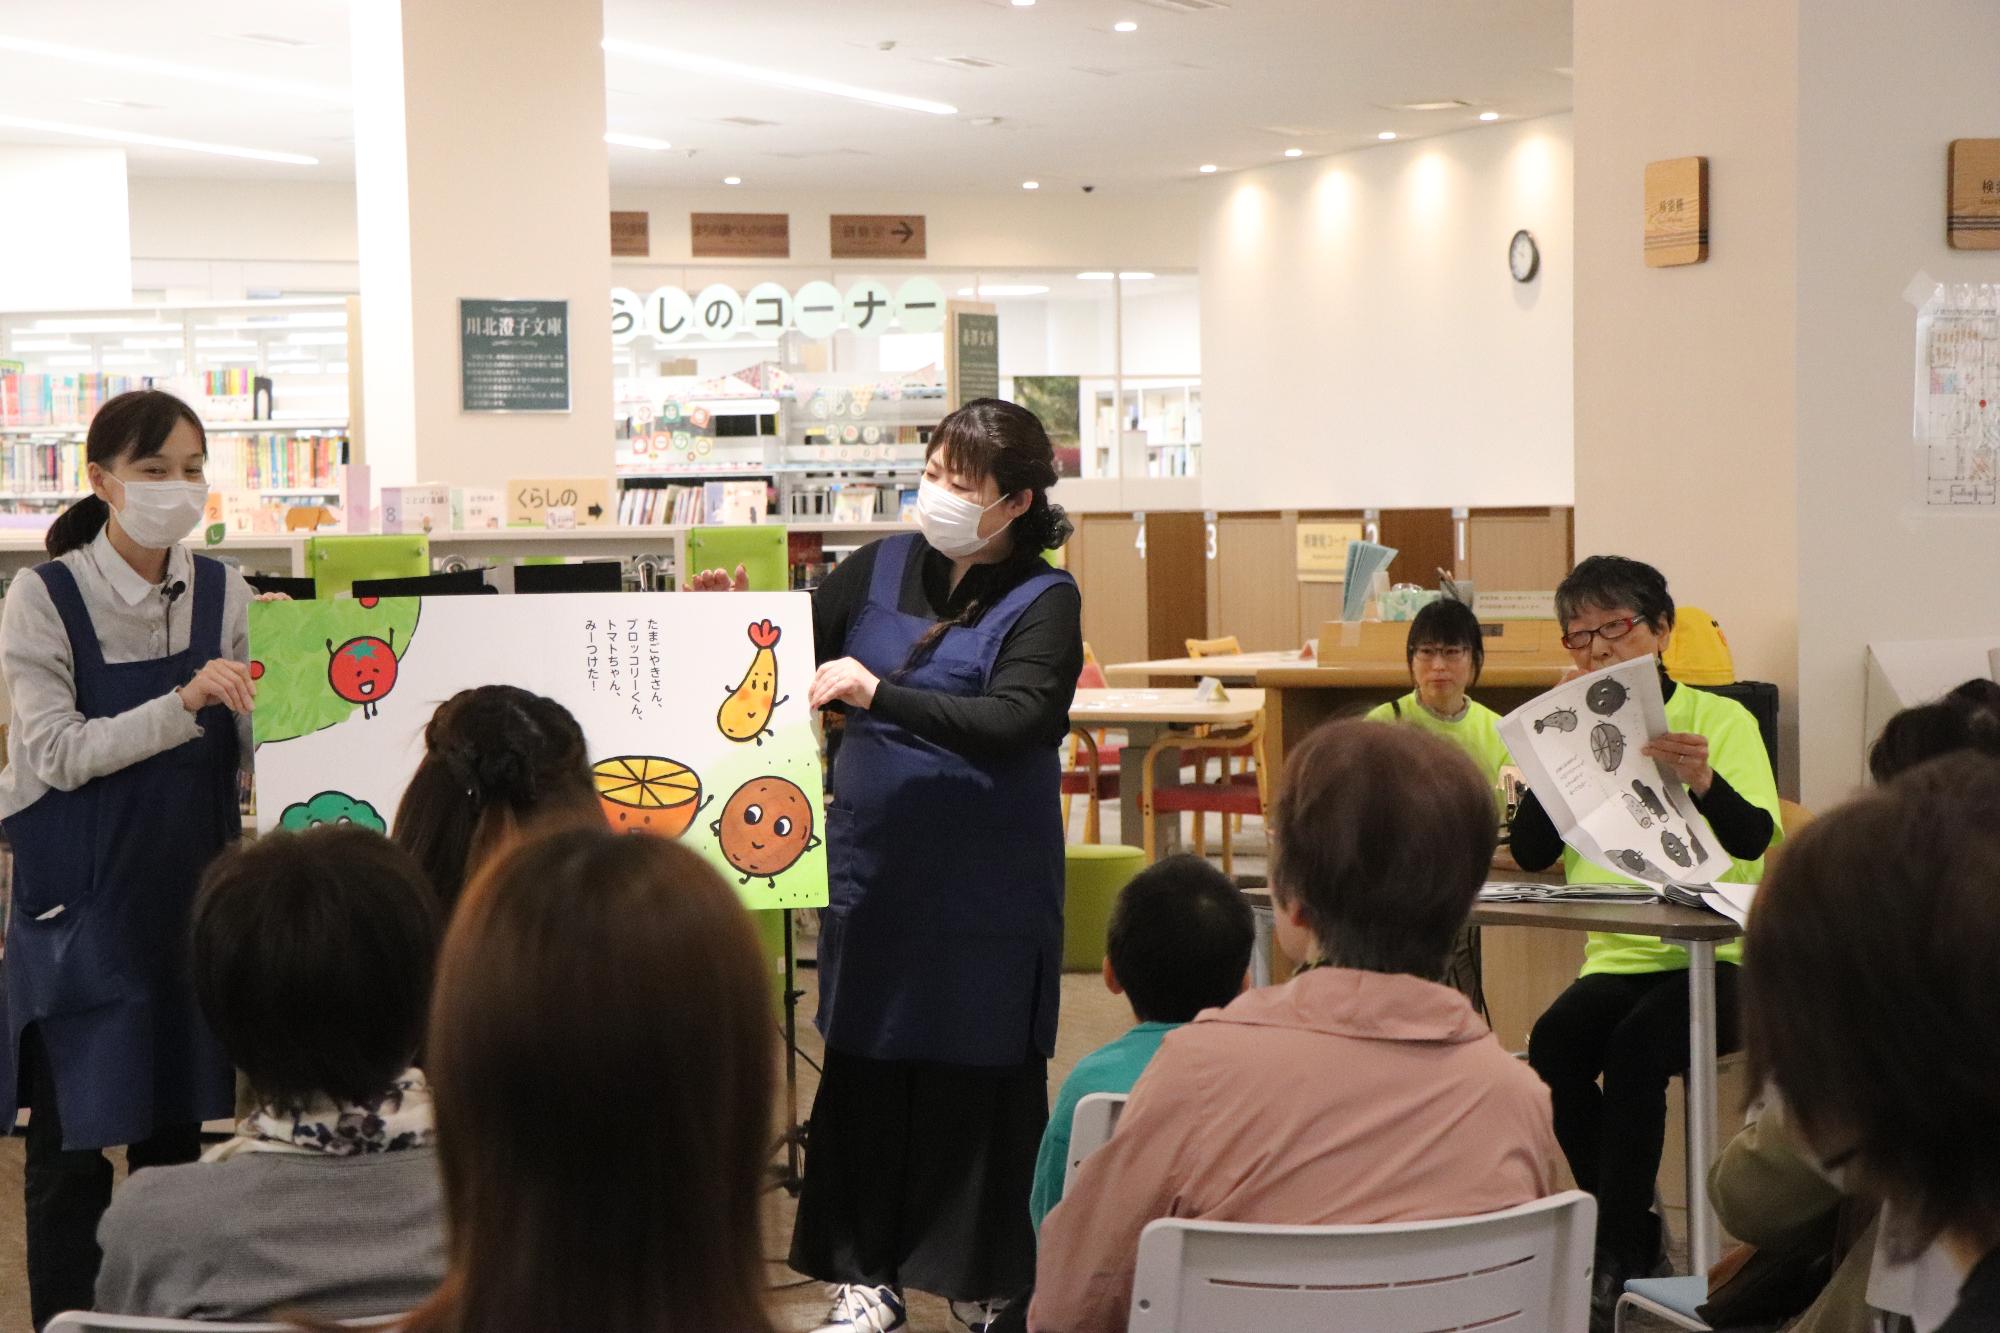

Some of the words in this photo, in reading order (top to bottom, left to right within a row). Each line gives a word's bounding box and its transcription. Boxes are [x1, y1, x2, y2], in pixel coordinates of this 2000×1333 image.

[466, 316, 562, 336] 川北澄子文庫
[386, 507, 396, 523] 8
[518, 488, 578, 509] くらしの
[1135, 525, 1146, 559] 4
[1206, 524, 1217, 559] 3
[606, 619, 621, 697] トマトちゃん、
[627, 619, 643, 720] ブロッコリーくん、
[648, 619, 662, 707] たまごやきさん、
